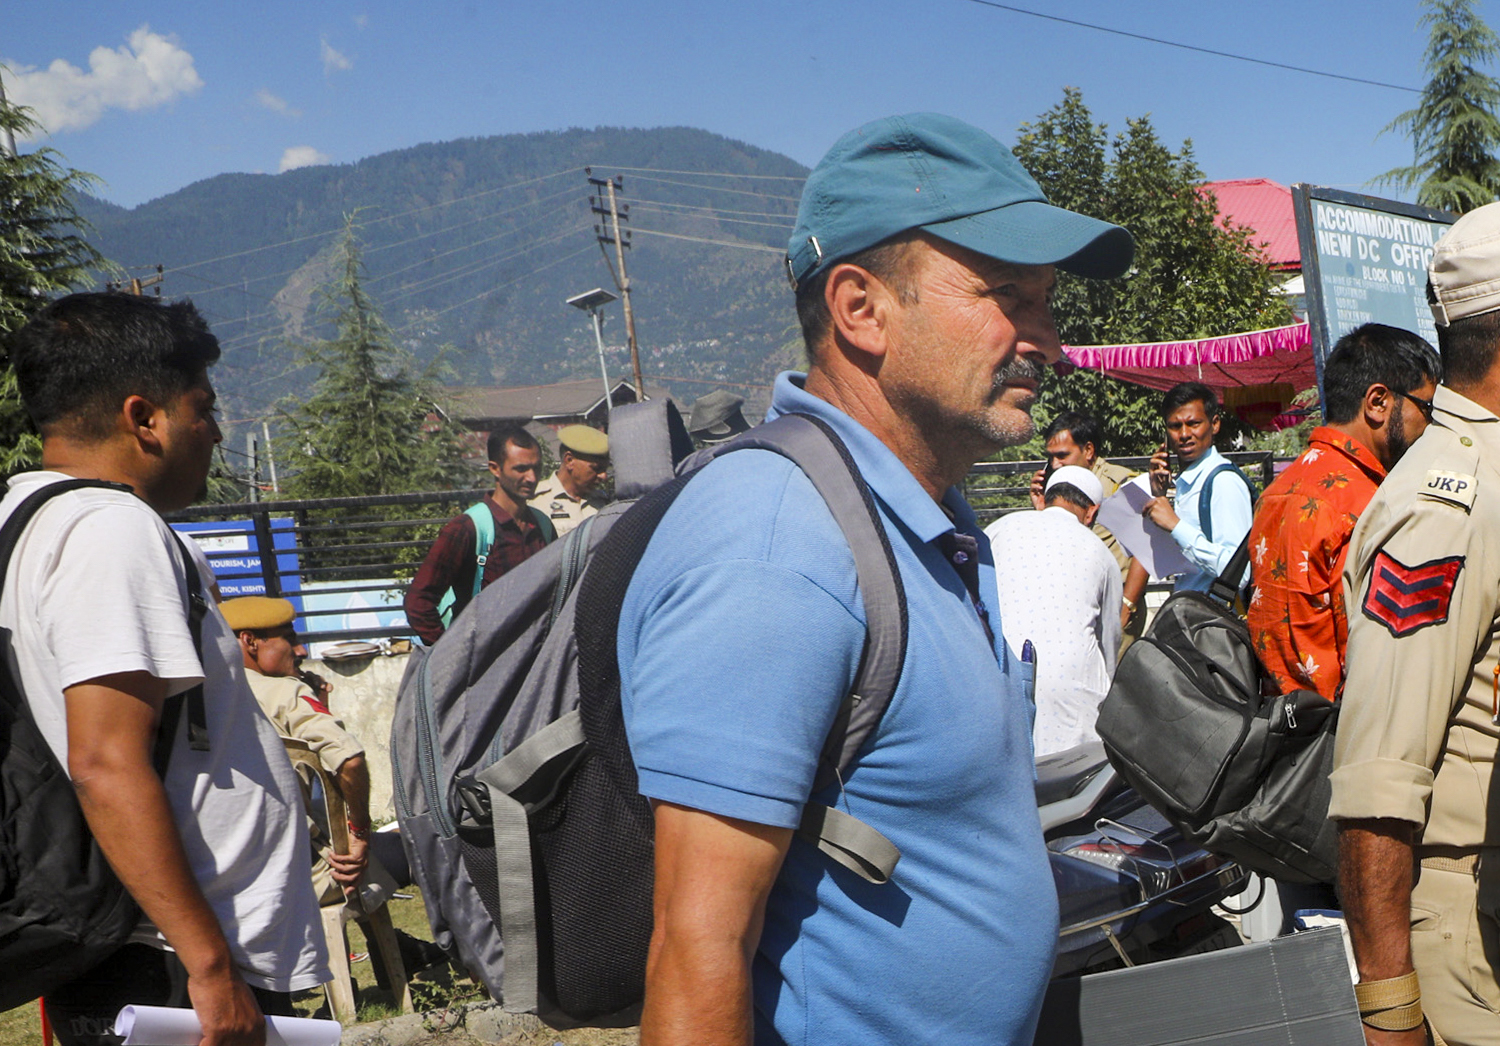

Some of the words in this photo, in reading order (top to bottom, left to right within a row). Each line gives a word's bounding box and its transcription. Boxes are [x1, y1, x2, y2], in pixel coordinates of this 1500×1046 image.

[1317, 204, 1434, 246] ACCOMMODATION
[1318, 230, 1352, 258] NEW
[1357, 236, 1381, 263] DC
[1362, 265, 1390, 284] BLOCK
[1391, 270, 1405, 285] NO
[1427, 476, 1468, 494] JKP
[210, 559, 246, 569] TOURISM,
